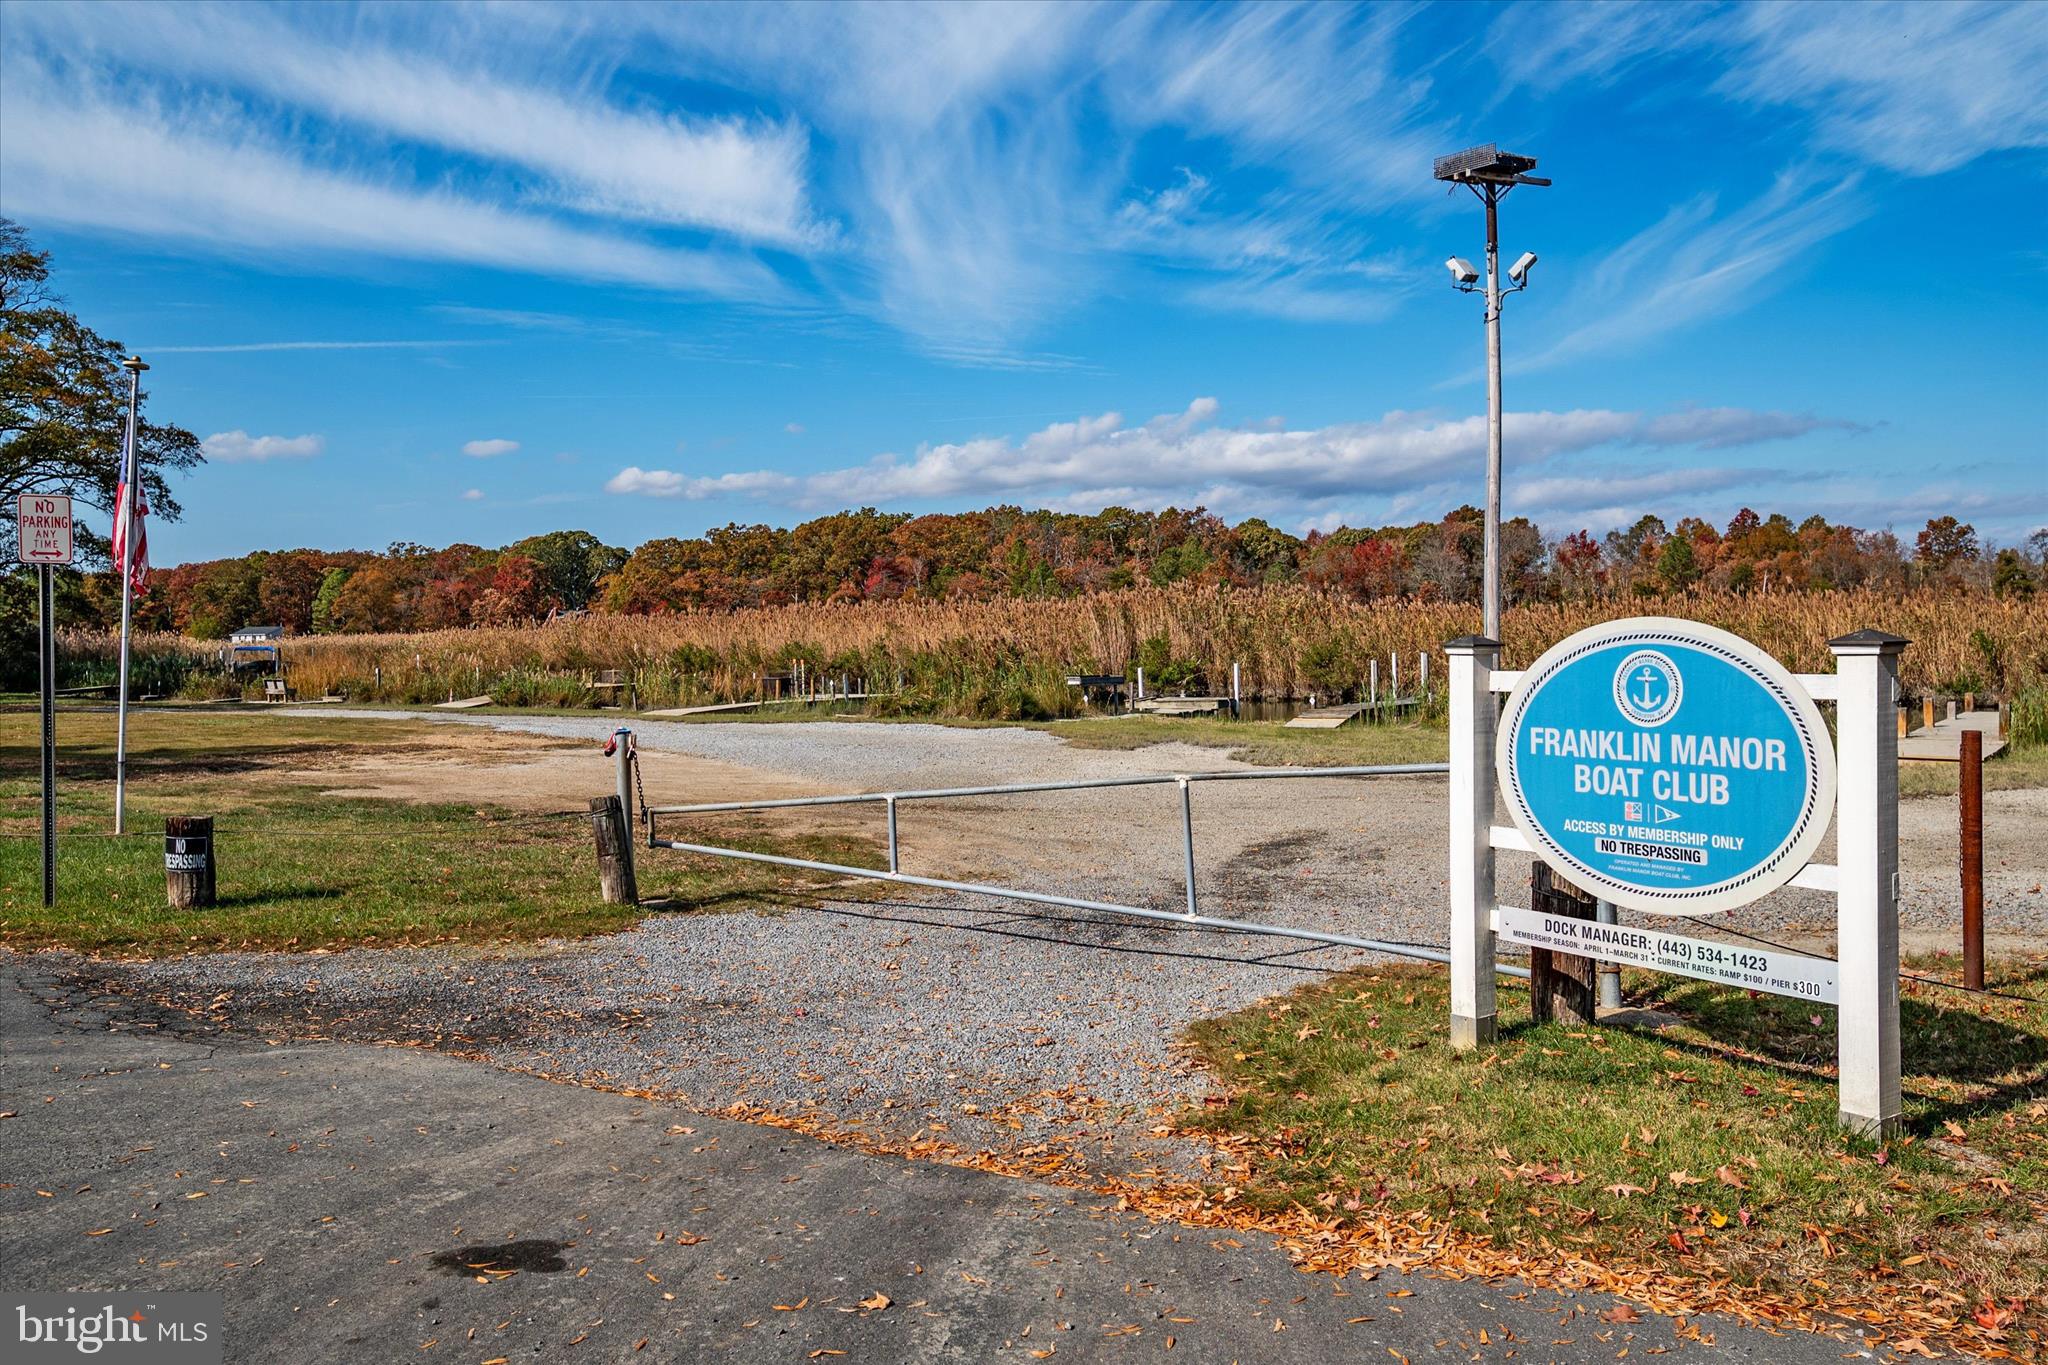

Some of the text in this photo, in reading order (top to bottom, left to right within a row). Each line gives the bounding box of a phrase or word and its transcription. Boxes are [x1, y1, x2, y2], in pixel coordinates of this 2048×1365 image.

[36, 501, 54, 513] NO
[23, 516, 67, 528] PARKING
[34, 540, 58, 548] TIME
[36, 530, 56, 538] ANY
[1530, 727, 1787, 771] FRANKLIN MANOR
[1574, 765, 1729, 805] BOAT CLUB
[1564, 819, 1744, 850] ACCESS BY MEMBERSHIP ONLY
[176, 840, 186, 853] NO
[1601, 840, 1700, 862] NO TRESPASSING
[1545, 919, 1767, 971] DOCK MANAGER: (443) 534-1423
[1513, 930, 1551, 943] MEMBERSHIP
[1554, 938, 1580, 949] SEASON:
[1584, 944, 1602, 953] APRIL
[1658, 957, 1689, 969] CURRENT
[1692, 964, 1717, 976] RATES:
[1719, 969, 1741, 980] RAMP
[1744, 974, 1763, 985] $100
[1772, 979, 1790, 989] PIER
[1793, 981, 1820, 997] $300
